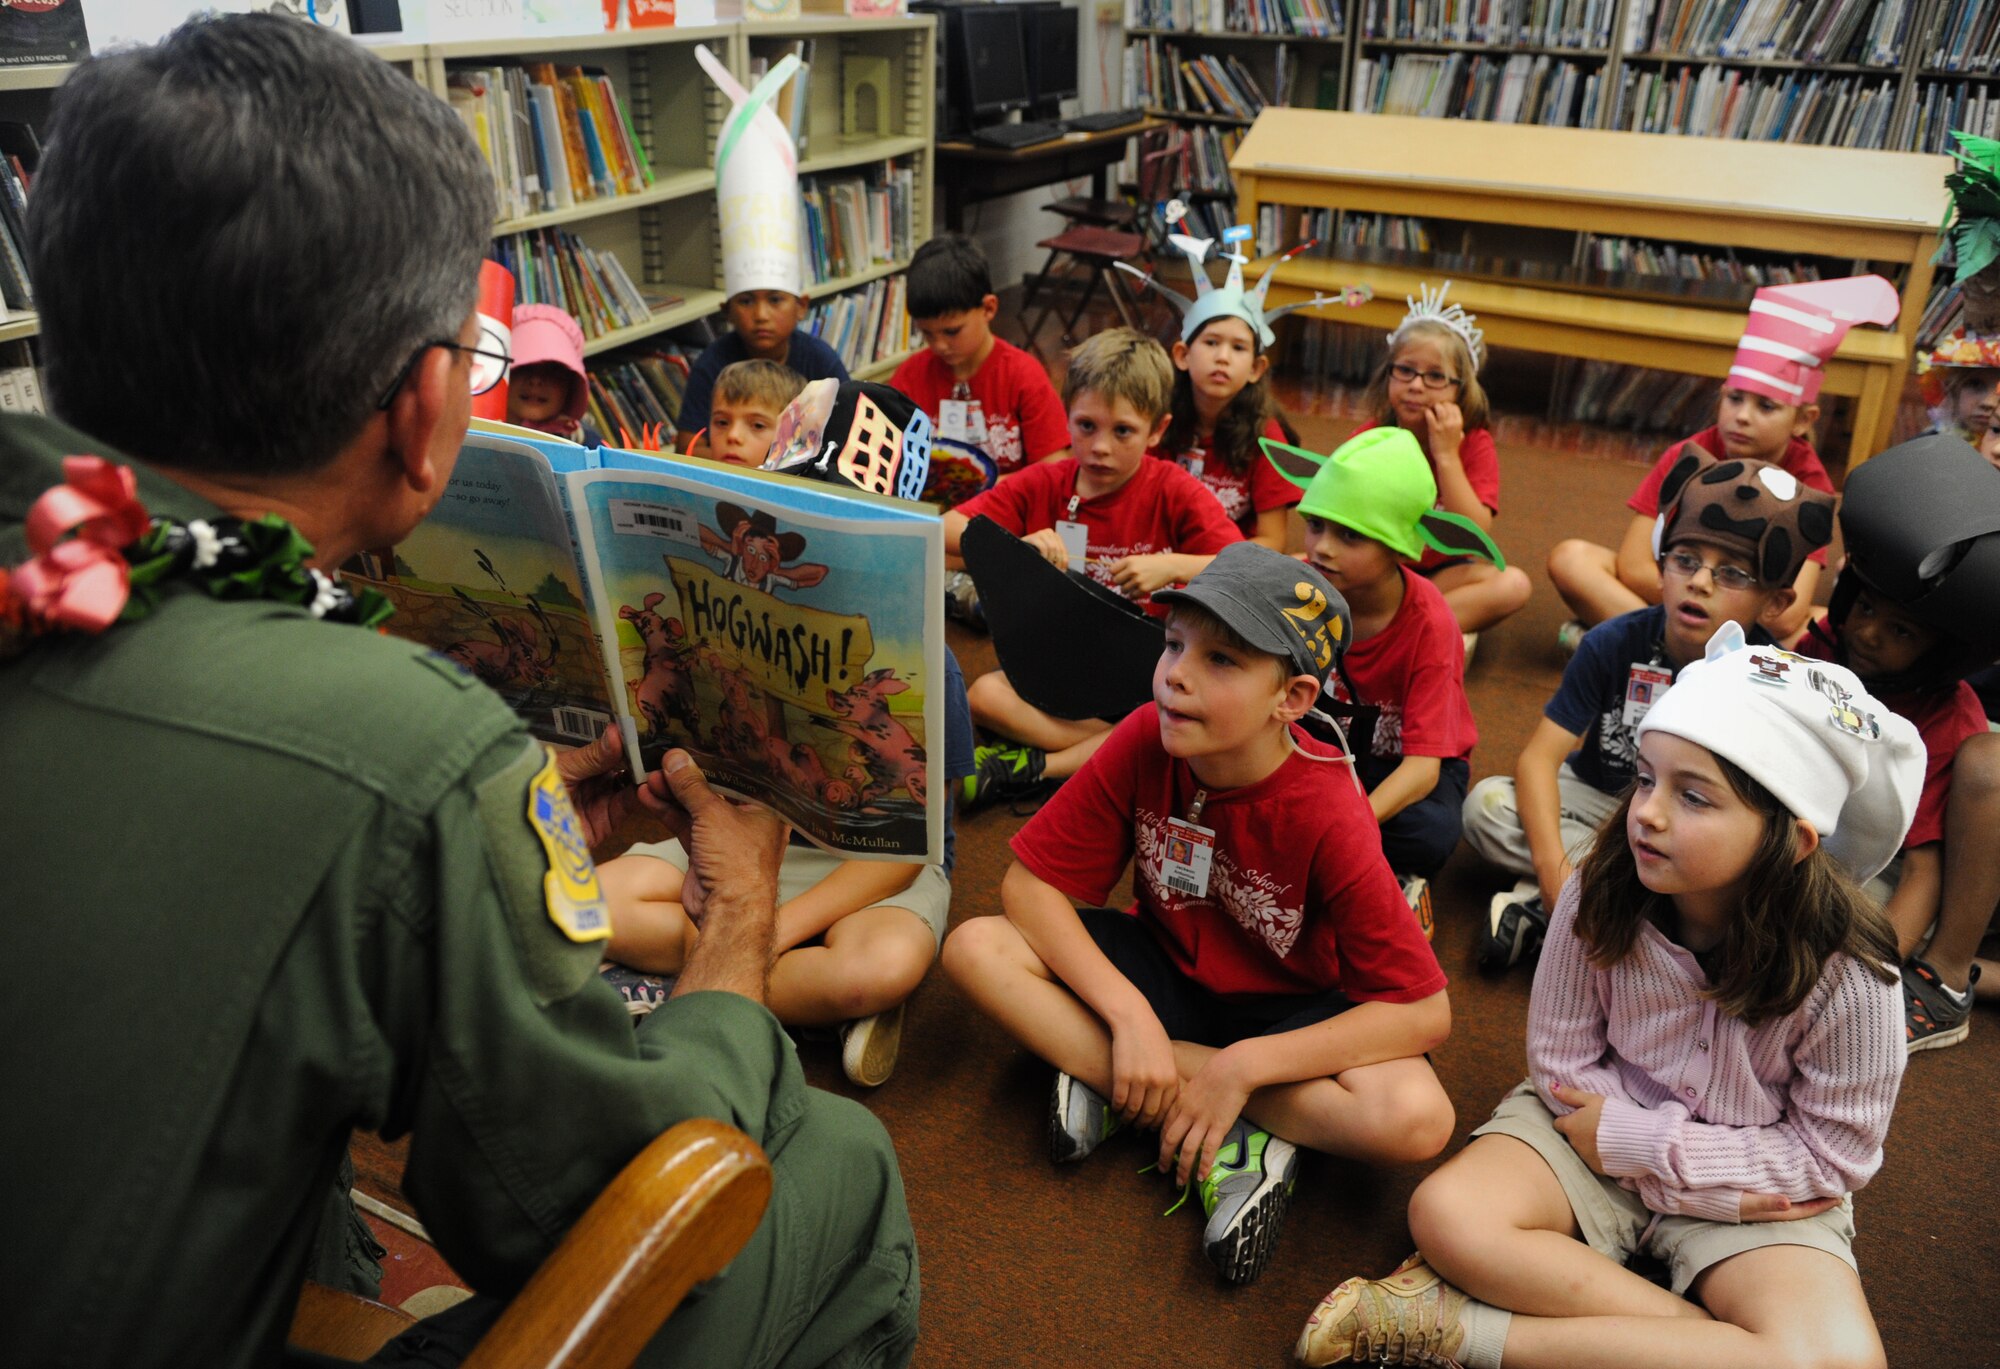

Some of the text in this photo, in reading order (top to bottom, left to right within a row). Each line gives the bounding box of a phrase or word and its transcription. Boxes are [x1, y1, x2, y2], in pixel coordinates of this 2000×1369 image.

[20, 55, 35, 63] LOU
[36, 54, 68, 63] FANCHER
[449, 478, 460, 487] or
[463, 479, 474, 488] us
[469, 494, 481, 504] go
[482, 496, 511, 509] away!
[687, 578, 853, 692] HOGWASH!
[718, 770, 757, 793] Wilson
[810, 822, 901, 849] Jim McMullan
[1240, 868, 1293, 896] School
